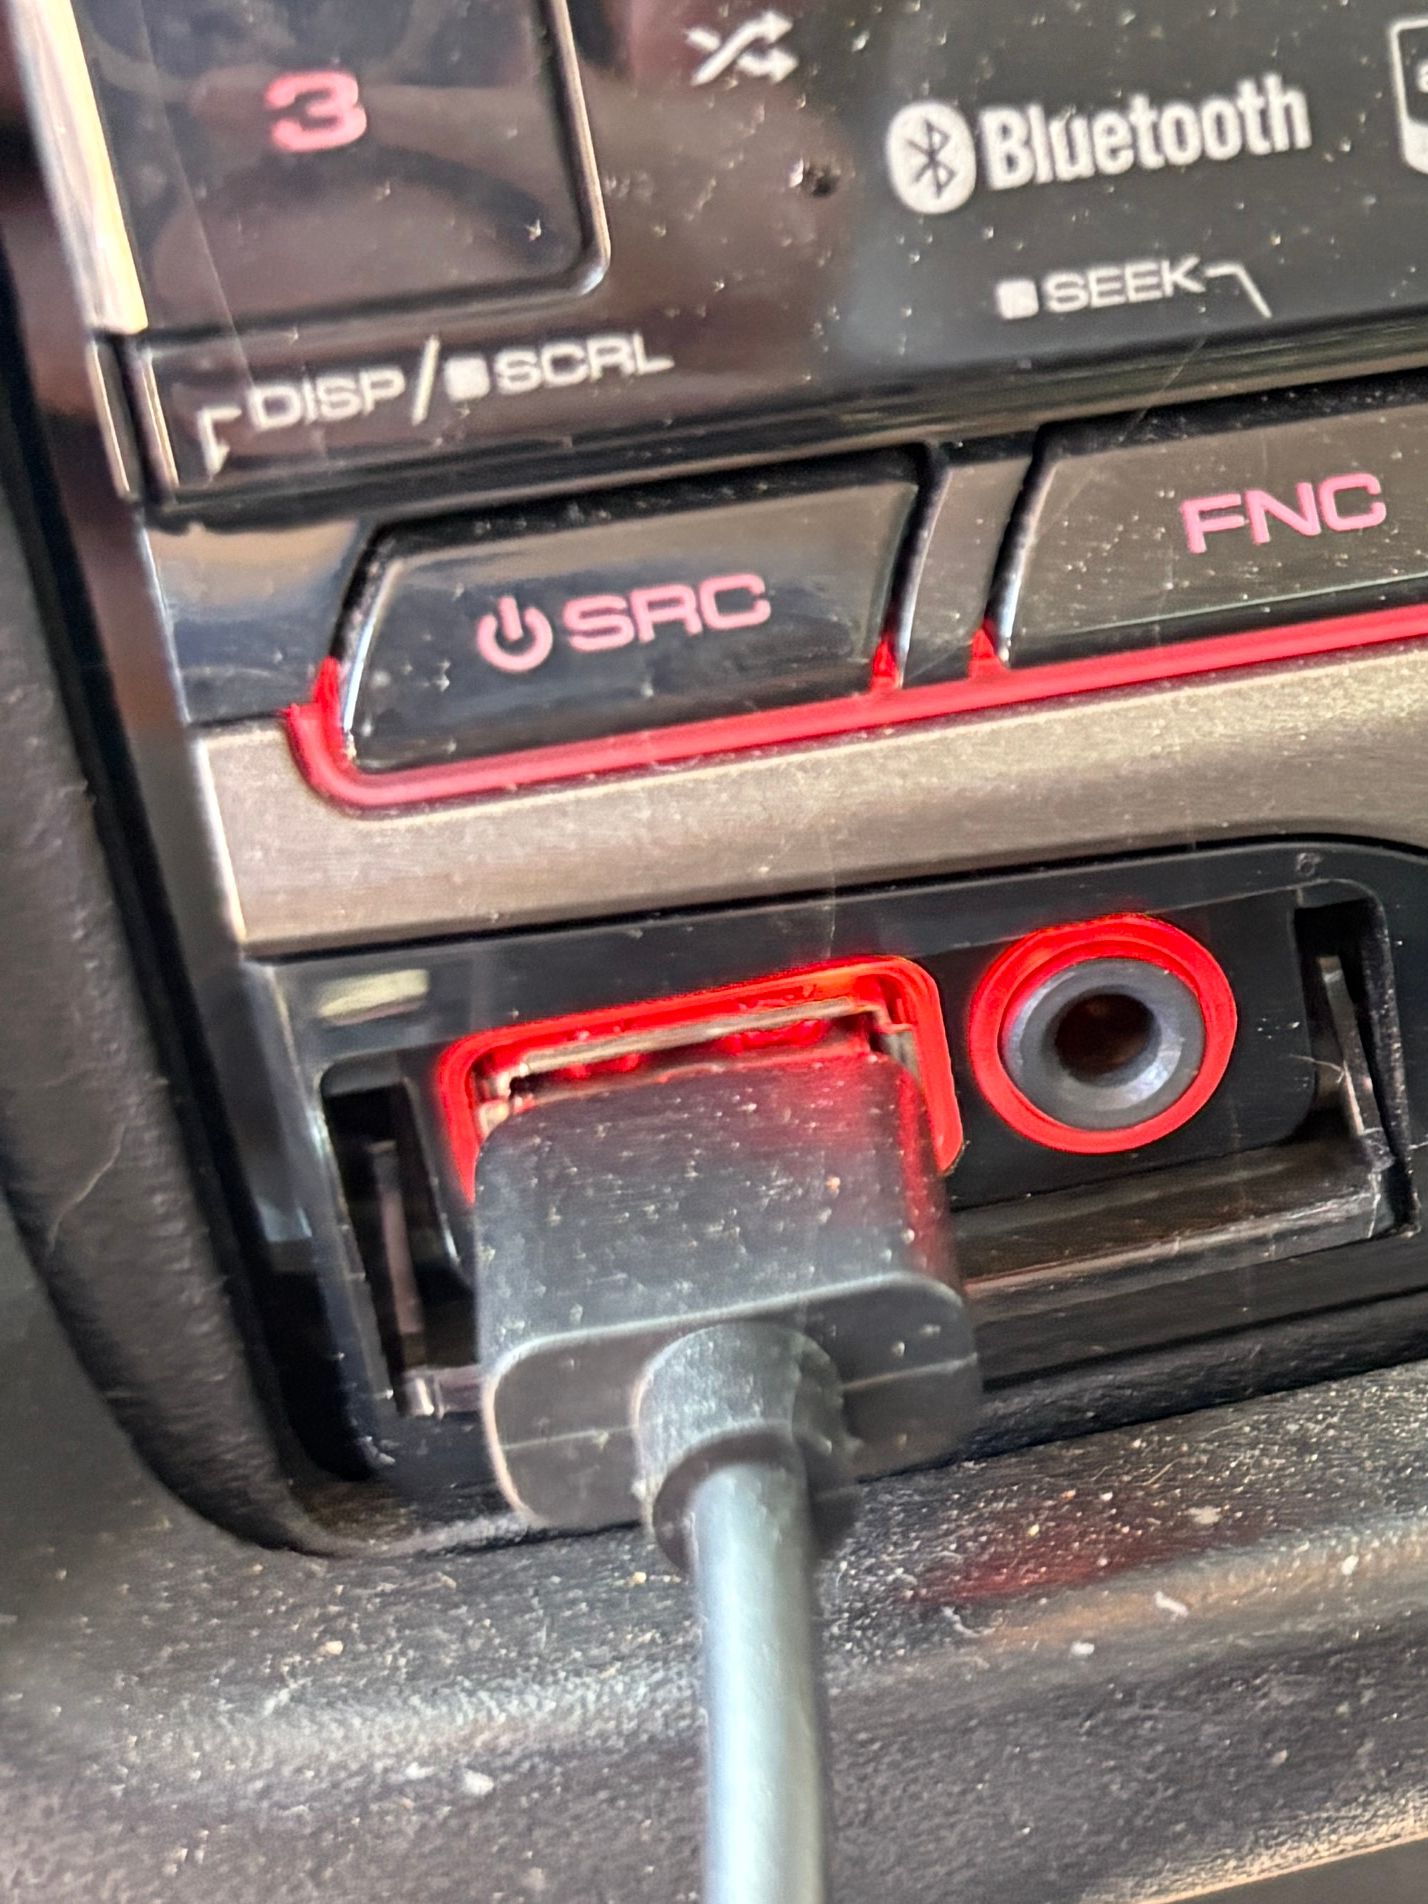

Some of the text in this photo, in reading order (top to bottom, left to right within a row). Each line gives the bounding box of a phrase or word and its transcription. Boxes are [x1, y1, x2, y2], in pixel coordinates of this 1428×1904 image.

[264, 70, 368, 154] 3
[980, 73, 1313, 190] Bluetooth
[1045, 256, 1206, 312] SEEK
[1181, 472, 1387, 554] FNC
[564, 573, 772, 653] SRC
